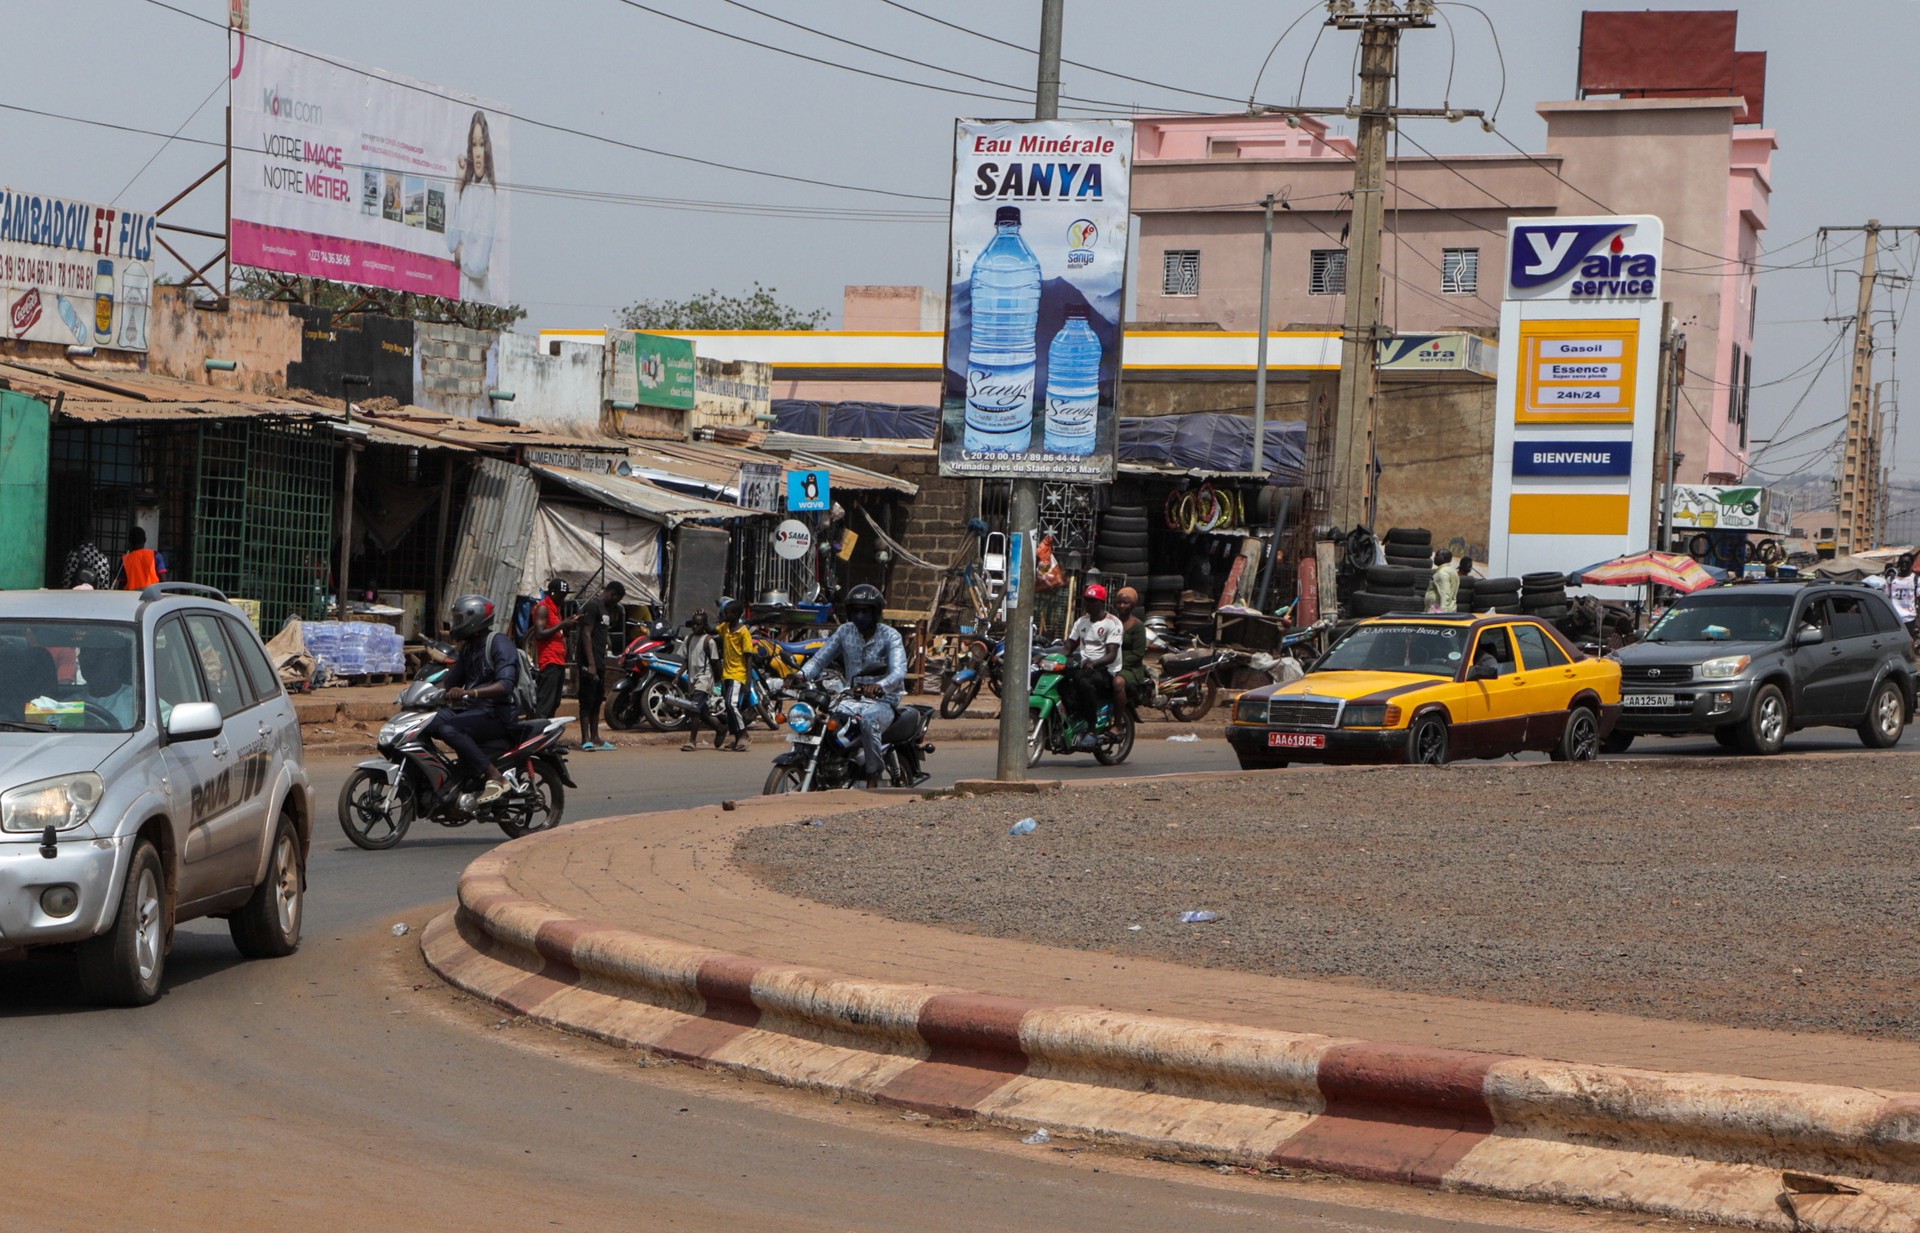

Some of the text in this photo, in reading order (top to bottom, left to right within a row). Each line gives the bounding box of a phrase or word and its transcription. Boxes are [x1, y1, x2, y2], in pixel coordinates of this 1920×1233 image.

[974, 135, 1115, 154] Eau Minérale
[263, 132, 301, 161] VOTRE
[304, 141, 343, 174] IMAGE,
[264, 165, 350, 202] NOTRE MÉTIER.
[974, 162, 1102, 197] SANYA
[94, 207, 115, 256] ET
[119, 212, 155, 262] FILS
[1068, 253, 1095, 266] sanya
[17, 257, 25, 282] 52
[27, 258, 35, 282] 04
[46, 260, 53, 284] 74
[58, 262, 66, 287] 78
[68, 263, 76, 288] 17
[1571, 279, 1654, 295] service
[1560, 345, 1602, 353] Gasoil
[1552, 365, 1608, 374] Essence
[968, 369, 1033, 406] Sanya
[1557, 391, 1601, 399] 24h/24
[527, 451, 580, 467] ALIMENTATION
[971, 452, 982, 460] 20
[984, 452, 995, 460] 20
[1011, 453, 1022, 461] 15
[1043, 454, 1054, 462] 86
[1056, 454, 1067, 462] 44
[1069, 454, 1081, 462] 44
[1533, 453, 1611, 463] BIENVENUE
[950, 462, 990, 471] Yirimadio
[1013, 464, 1024, 472] du
[1026, 464, 1050, 472] Stade
[1053, 465, 1064, 473] du
[1066, 465, 1077, 473] 26
[1079, 465, 1101, 474] Mars
[788, 531, 809, 540] SAMA
[1371, 627, 1439, 636] Mercedes-Benz
[1629, 696, 1668, 706] AA125AV
[1275, 734, 1317, 747] AA618DE
[190, 767, 230, 825] RAV4
